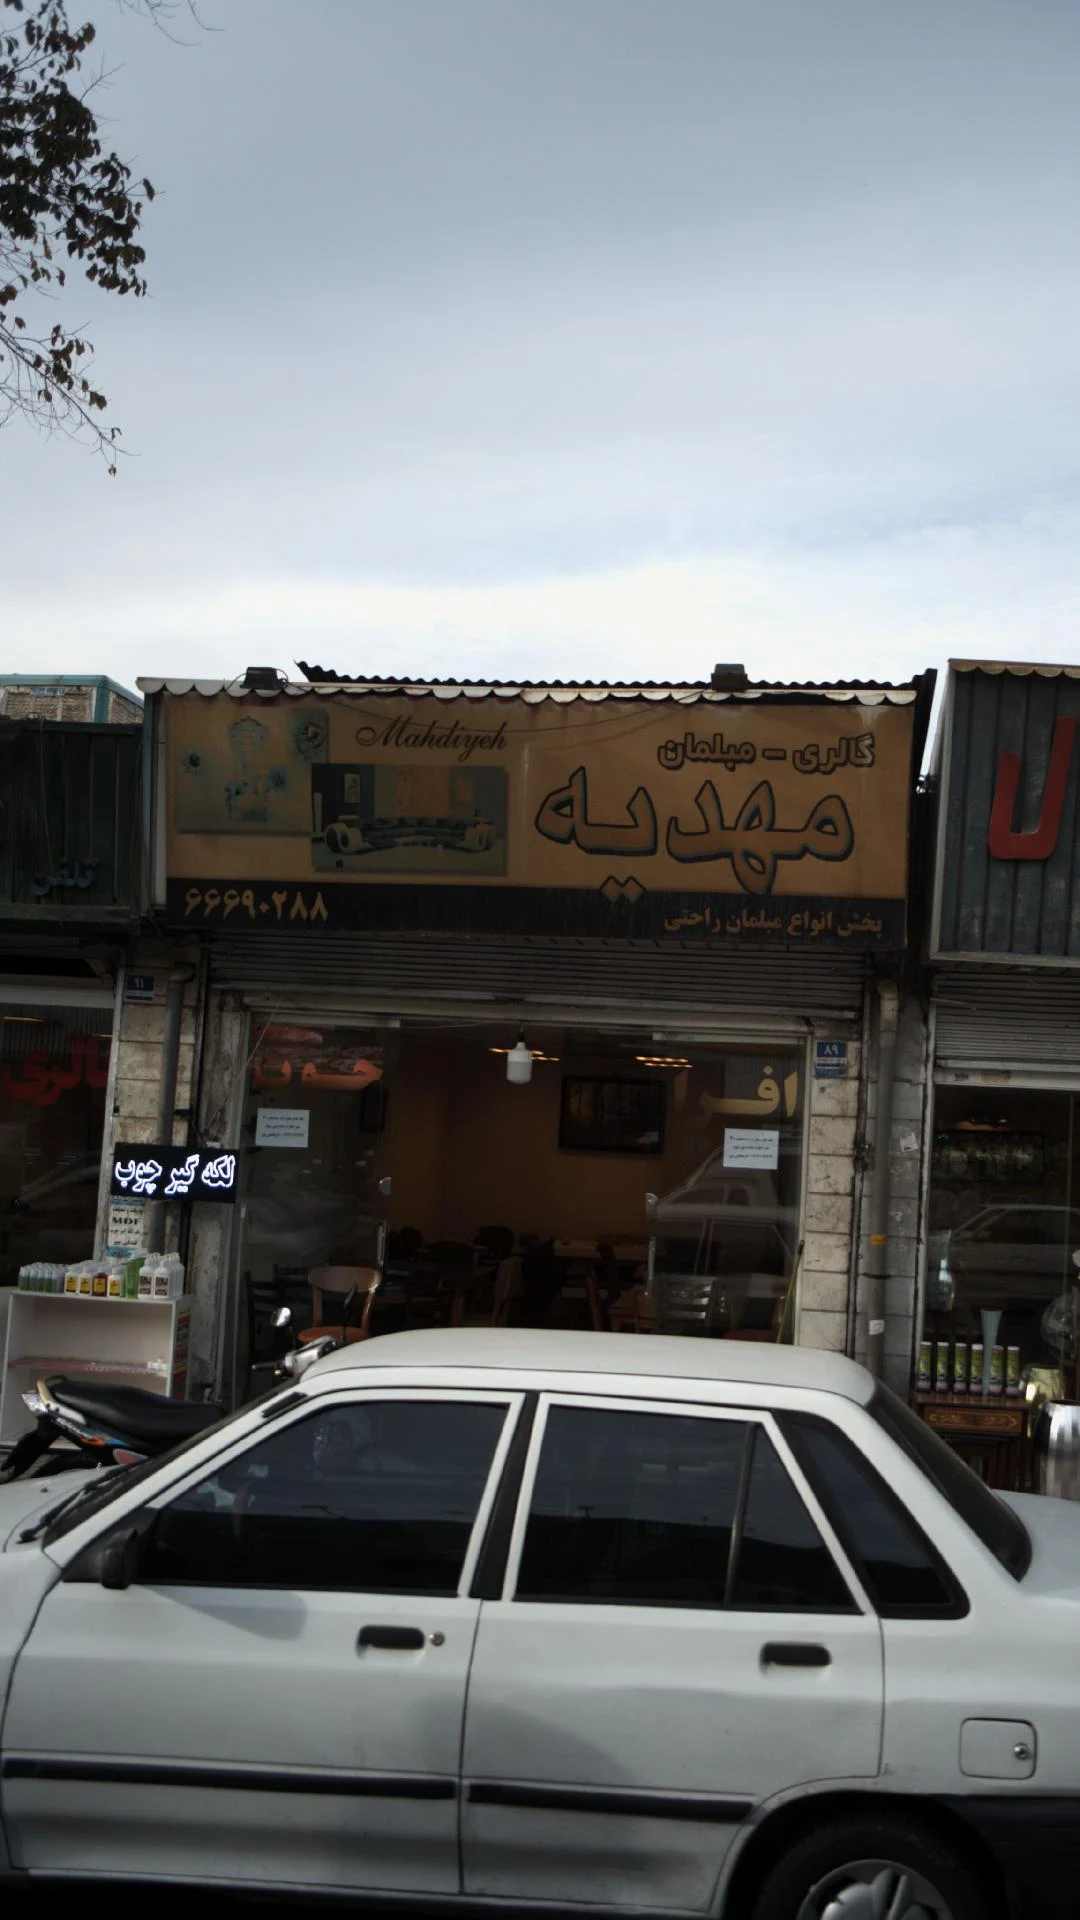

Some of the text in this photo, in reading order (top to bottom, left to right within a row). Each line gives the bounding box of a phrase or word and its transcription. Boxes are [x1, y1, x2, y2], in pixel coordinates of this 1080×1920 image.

[354, 715, 509, 762] Mahdiyeh
[657, 732, 757, 772] مبلمان
[792, 733, 876, 774] گالری
[534, 765, 856, 904] مهدیه
[184, 887, 329, 922] ۶۶۶۹۰۲۸۸
[663, 906, 721, 933] راحتی
[725, 907, 782, 935] مبلمان
[788, 910, 832, 936] انواع
[1, 1034, 109, 1107] الری
[114, 1153, 236, 1194] لکه گیر چوب
